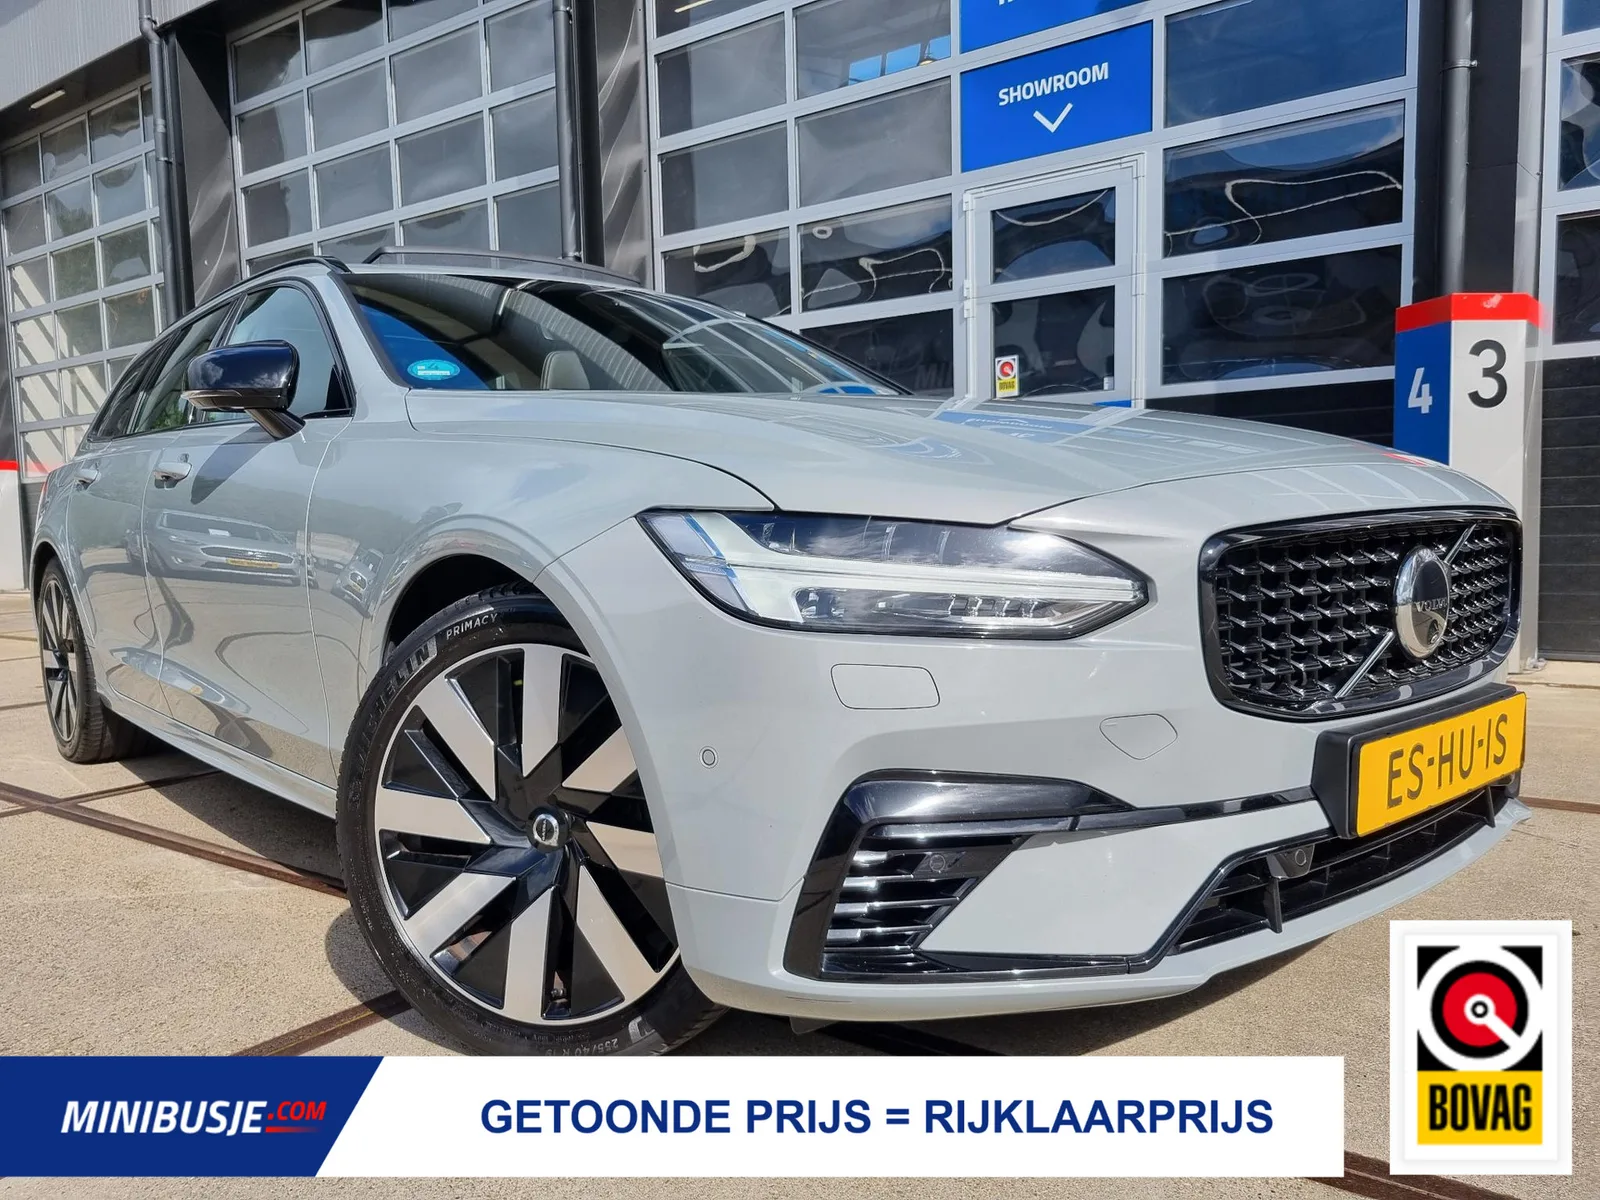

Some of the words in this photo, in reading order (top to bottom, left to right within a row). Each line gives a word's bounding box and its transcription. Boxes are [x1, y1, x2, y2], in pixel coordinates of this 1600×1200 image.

[998, 62, 1109, 106] SHOWROOM
[1408, 367, 1433, 414] 4
[1468, 339, 1508, 409] 3
[446, 613, 498, 640] PRIMACY
[1387, 713, 1508, 809] ES-HU-IS
